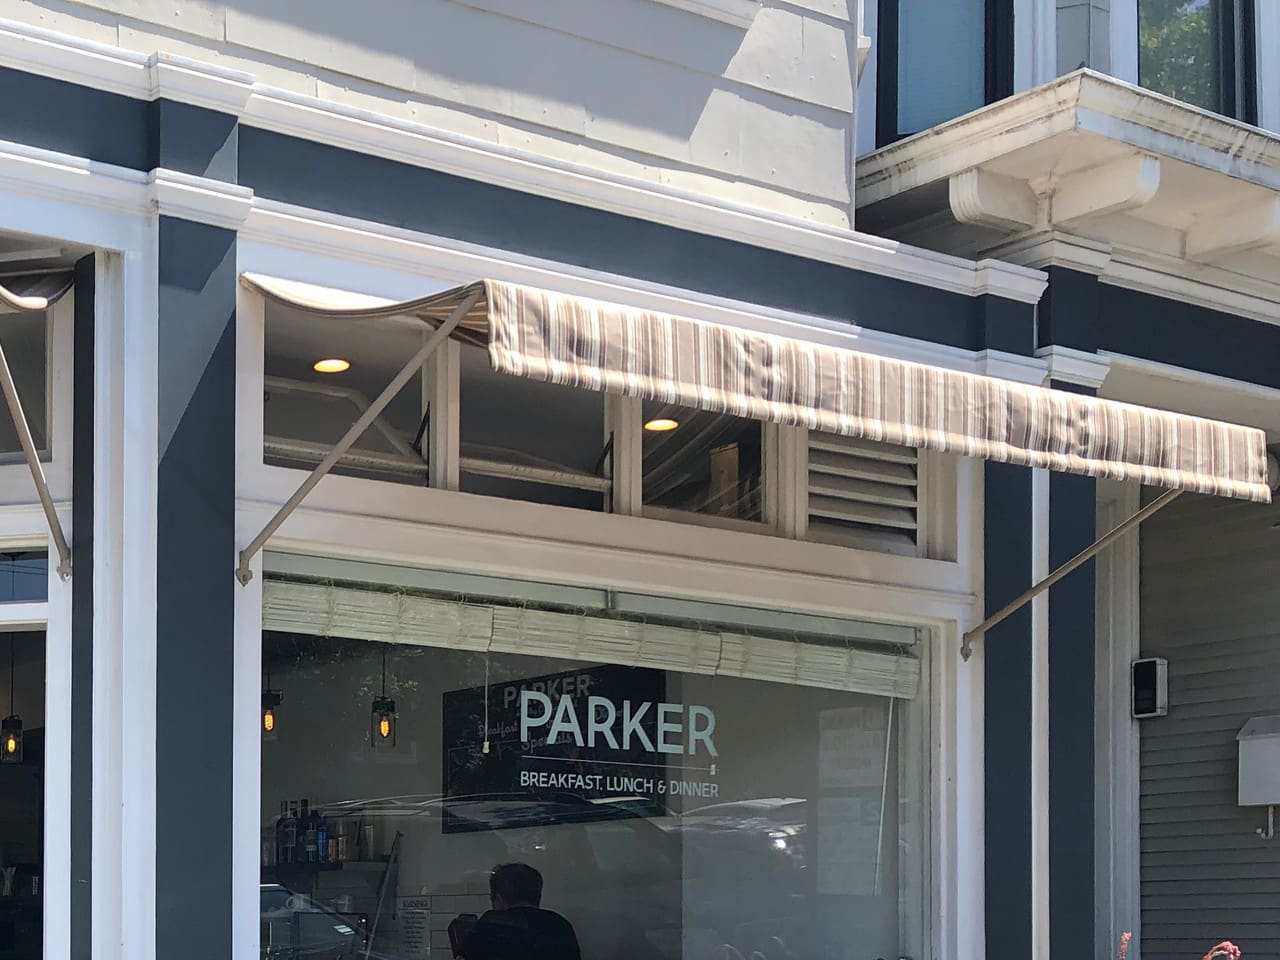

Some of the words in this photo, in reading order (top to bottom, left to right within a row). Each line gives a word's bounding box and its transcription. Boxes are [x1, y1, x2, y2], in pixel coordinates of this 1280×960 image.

[519, 690, 719, 757] PARKER
[521, 732, 572, 753] Specals
[520, 770, 603, 791] BREAKFAST,
[606, 775, 654, 794] LUNCH
[657, 780, 667, 794] &
[670, 780, 719, 798] DINNER
